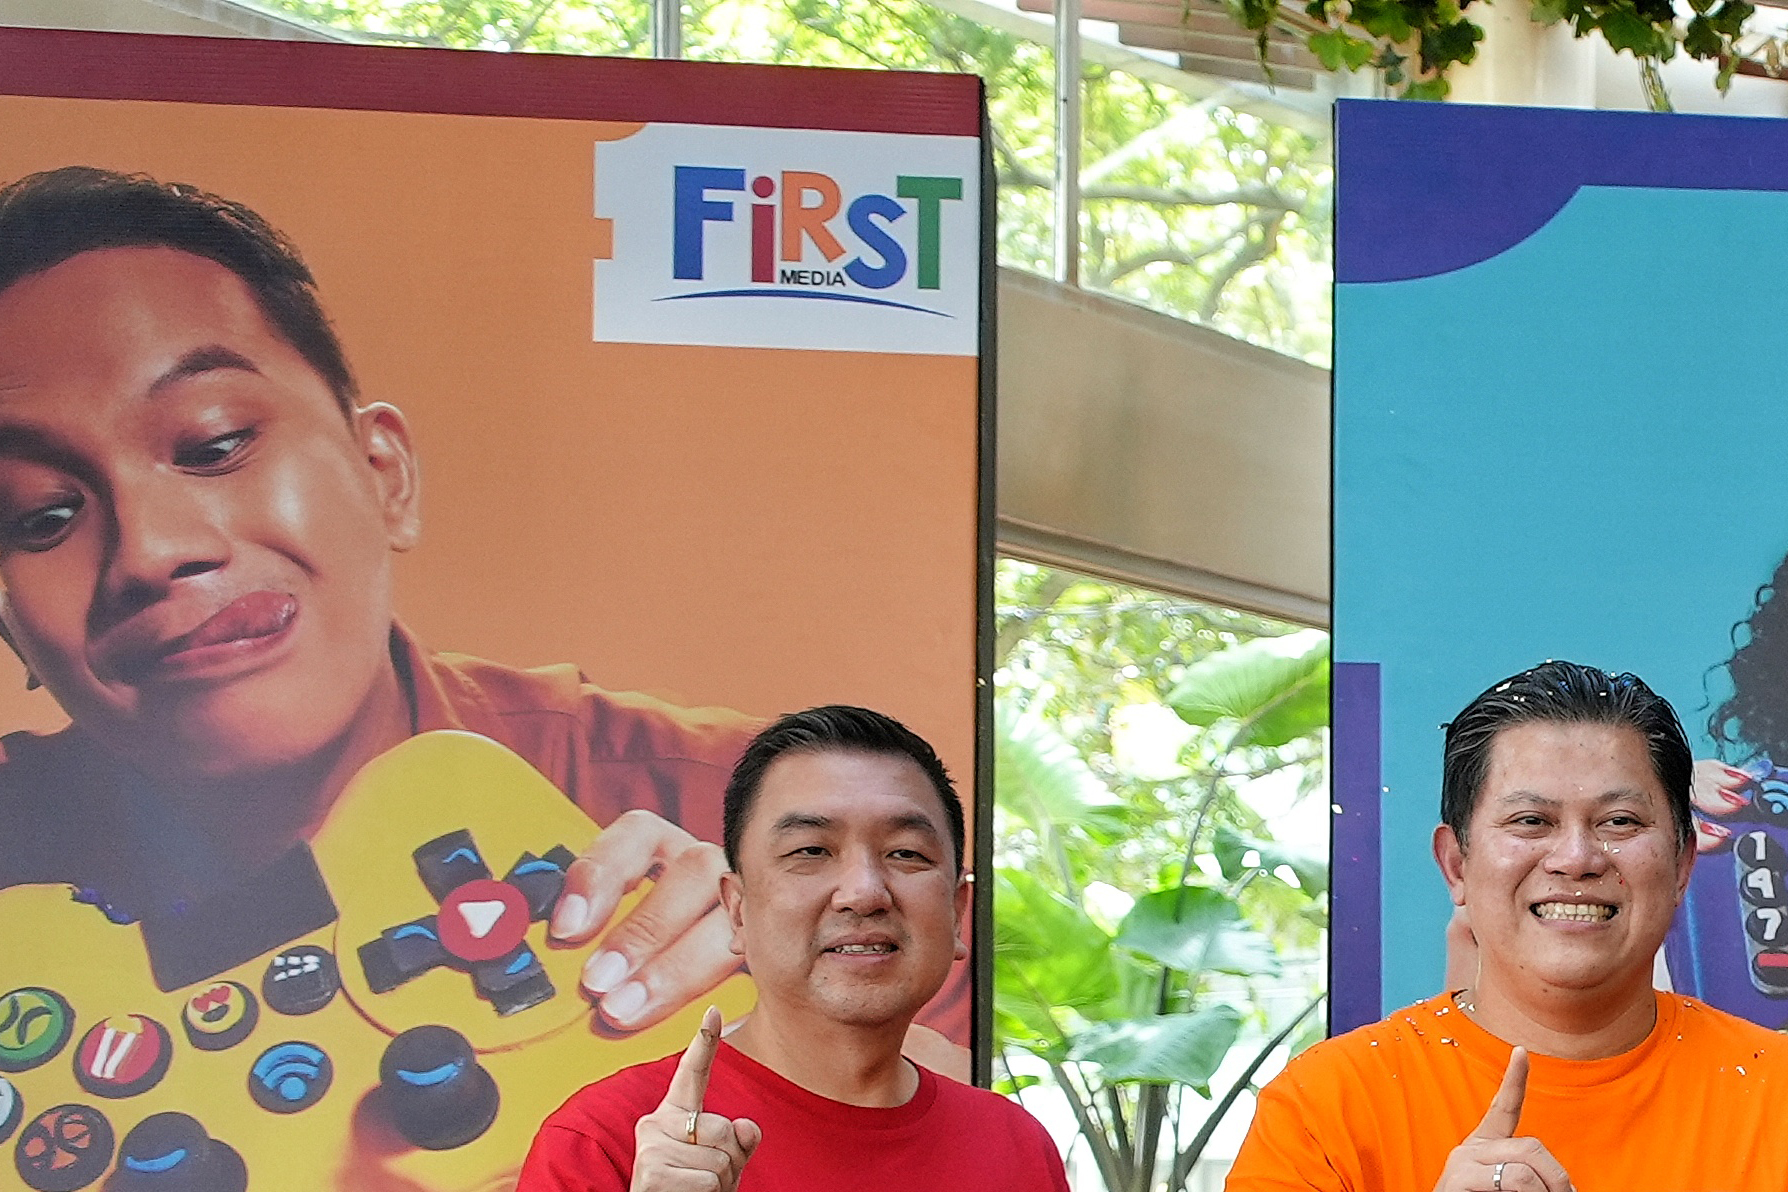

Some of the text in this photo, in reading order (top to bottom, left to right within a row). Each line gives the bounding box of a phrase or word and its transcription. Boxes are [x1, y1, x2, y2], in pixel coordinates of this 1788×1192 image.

[780, 269, 846, 287] MEDIA
[1749, 831, 1767, 861] 1
[1756, 907, 1783, 941] 7
